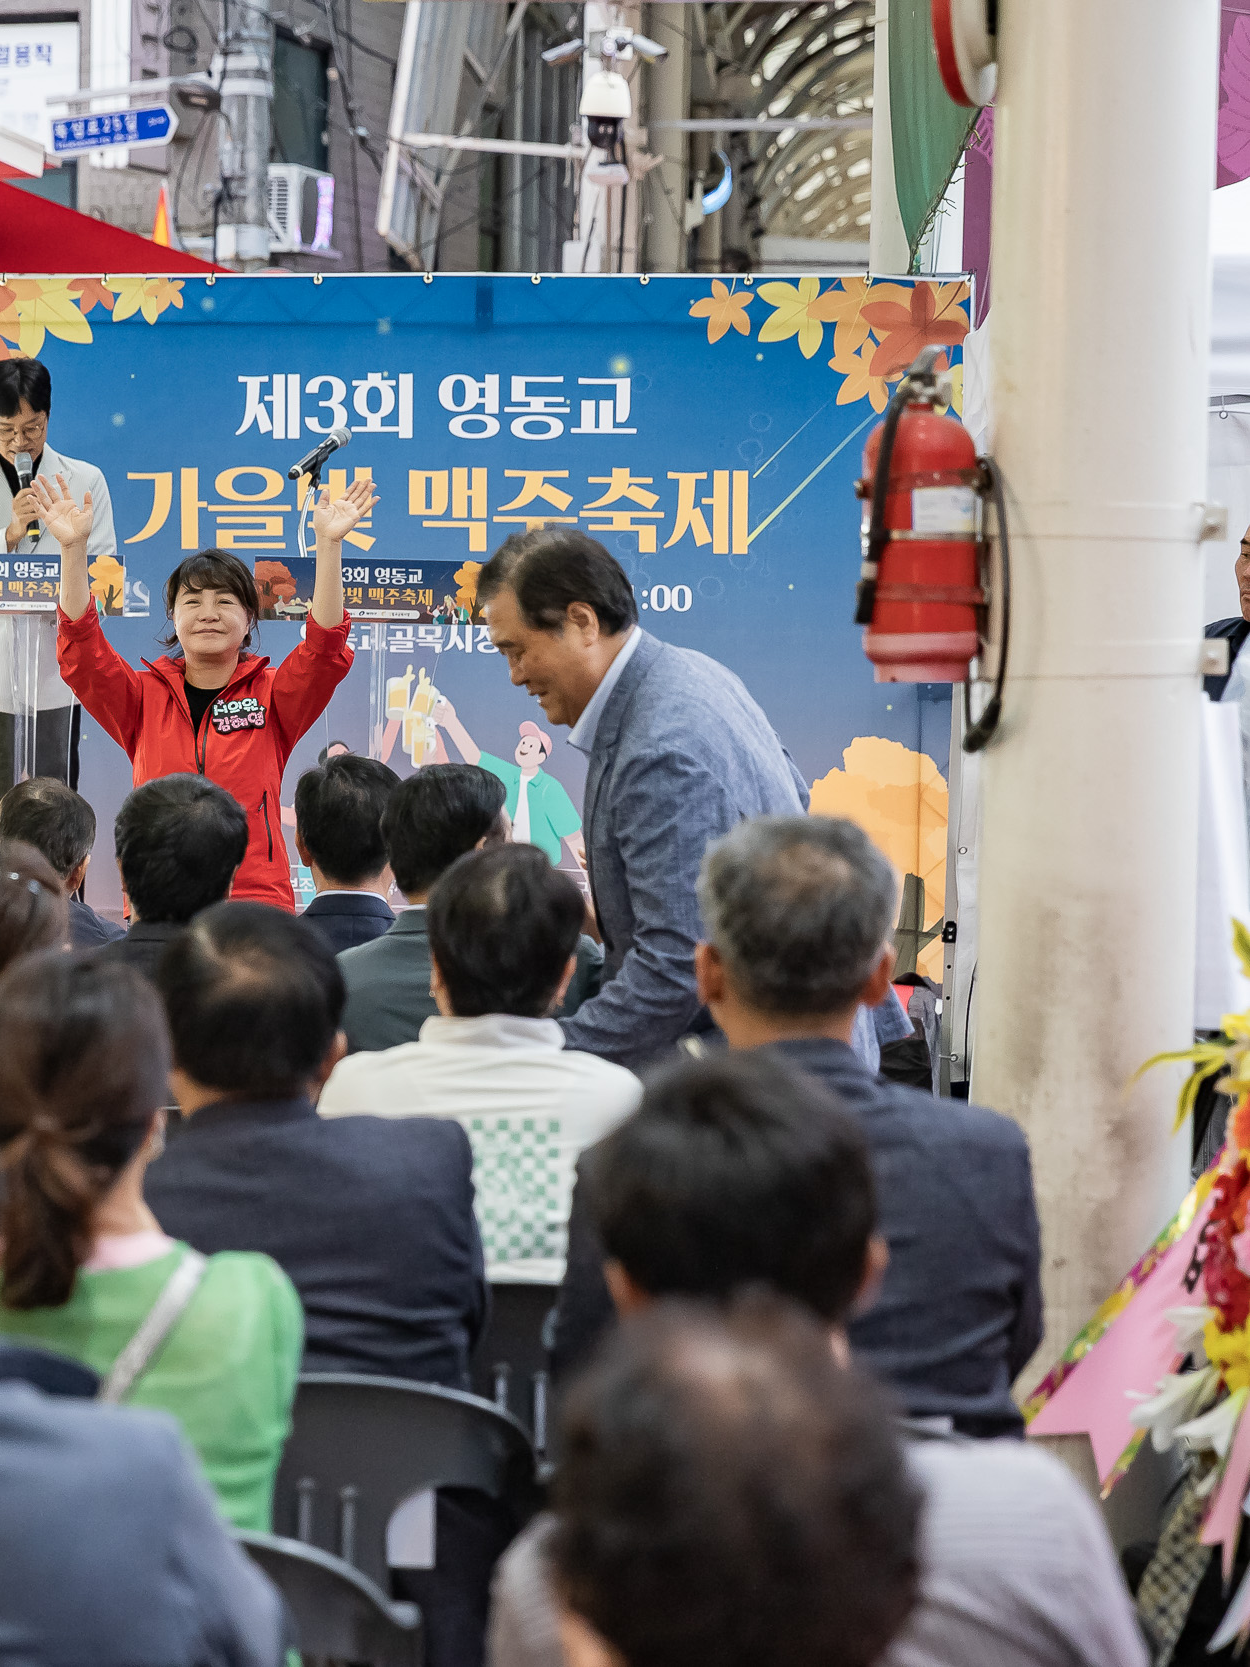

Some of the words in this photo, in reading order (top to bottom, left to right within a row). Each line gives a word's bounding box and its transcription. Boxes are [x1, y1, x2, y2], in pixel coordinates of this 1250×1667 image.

[235, 373, 413, 440] 제3회
[438, 373, 638, 440] 영동교
[408, 466, 749, 555] 맥주축제
[13, 562, 59, 578] 영동교
[342, 566, 369, 584] 3회
[374, 568, 423, 585] 영동교
[368, 589, 433, 606] 맥주축제
[631, 584, 693, 612] :00
